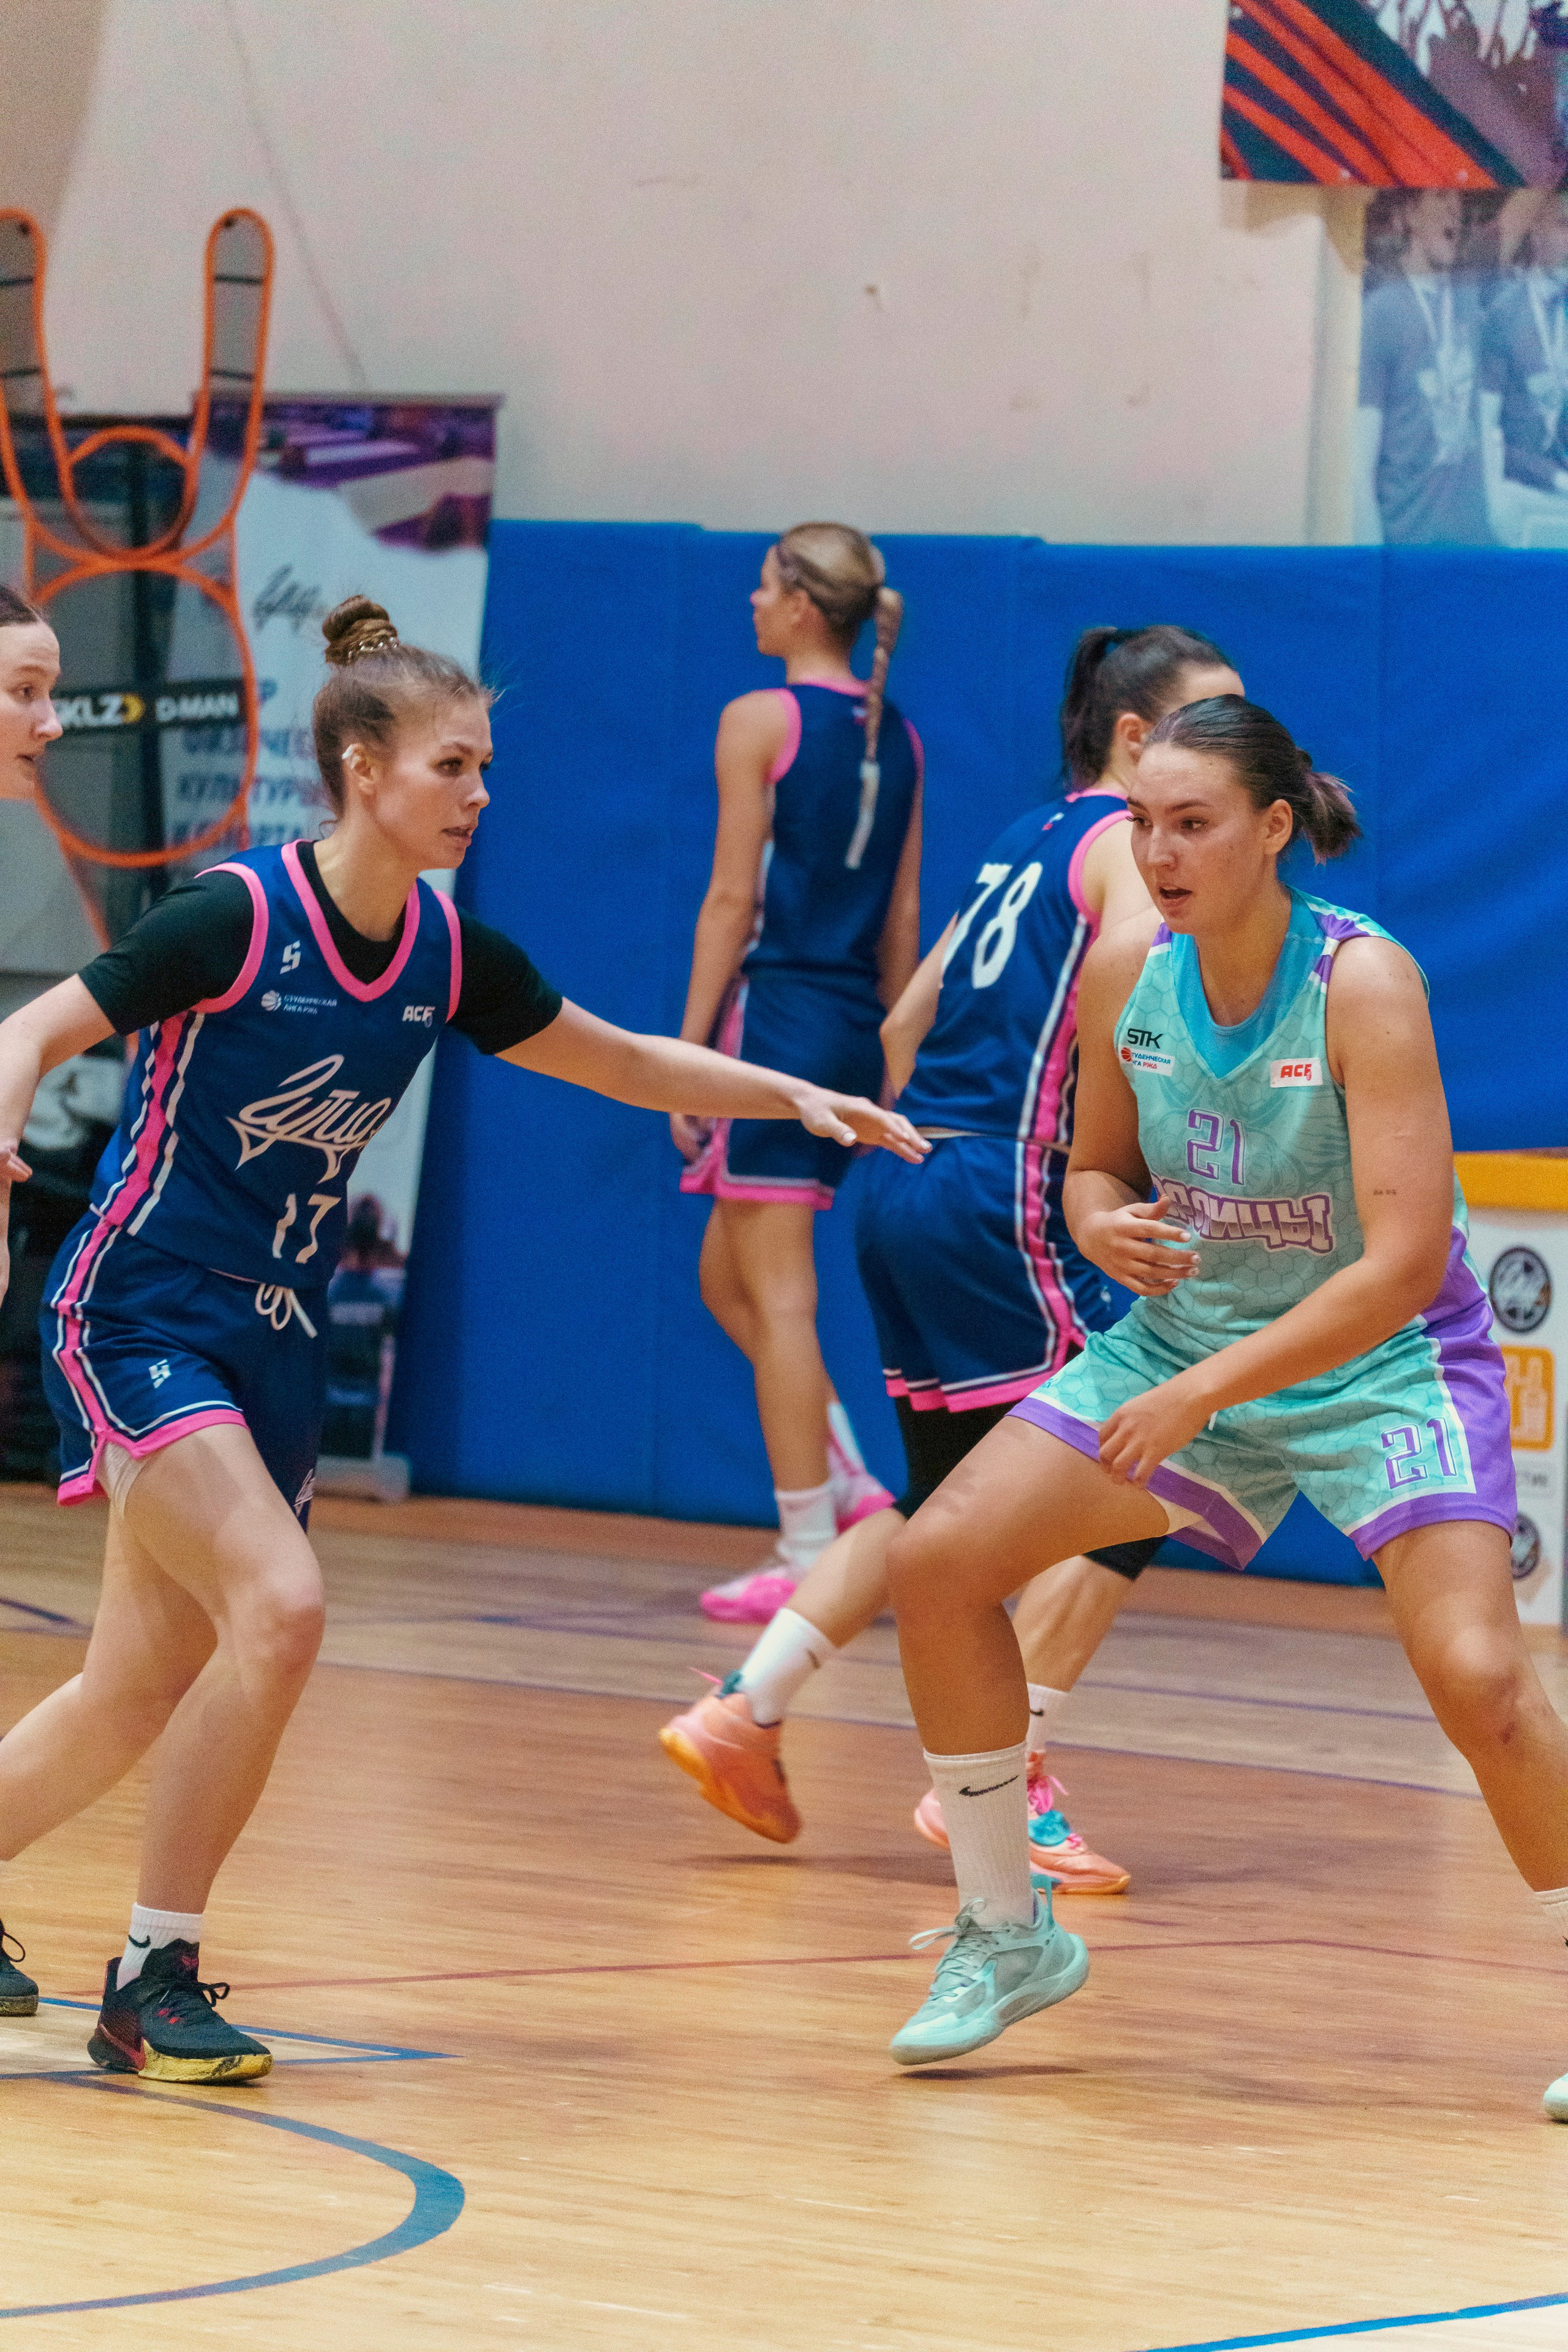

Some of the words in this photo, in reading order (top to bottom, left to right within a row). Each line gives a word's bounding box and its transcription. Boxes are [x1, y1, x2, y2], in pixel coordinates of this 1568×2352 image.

[941, 861, 1043, 990] 78
[1127, 1028, 1164, 1049] STK
[1131, 1052, 1171, 1065] ТУДЕНЧЕСКАЯ
[1186, 1108, 1246, 1186] 21
[272, 1193, 342, 1264] 17
[1381, 1417, 1458, 1490] 21
